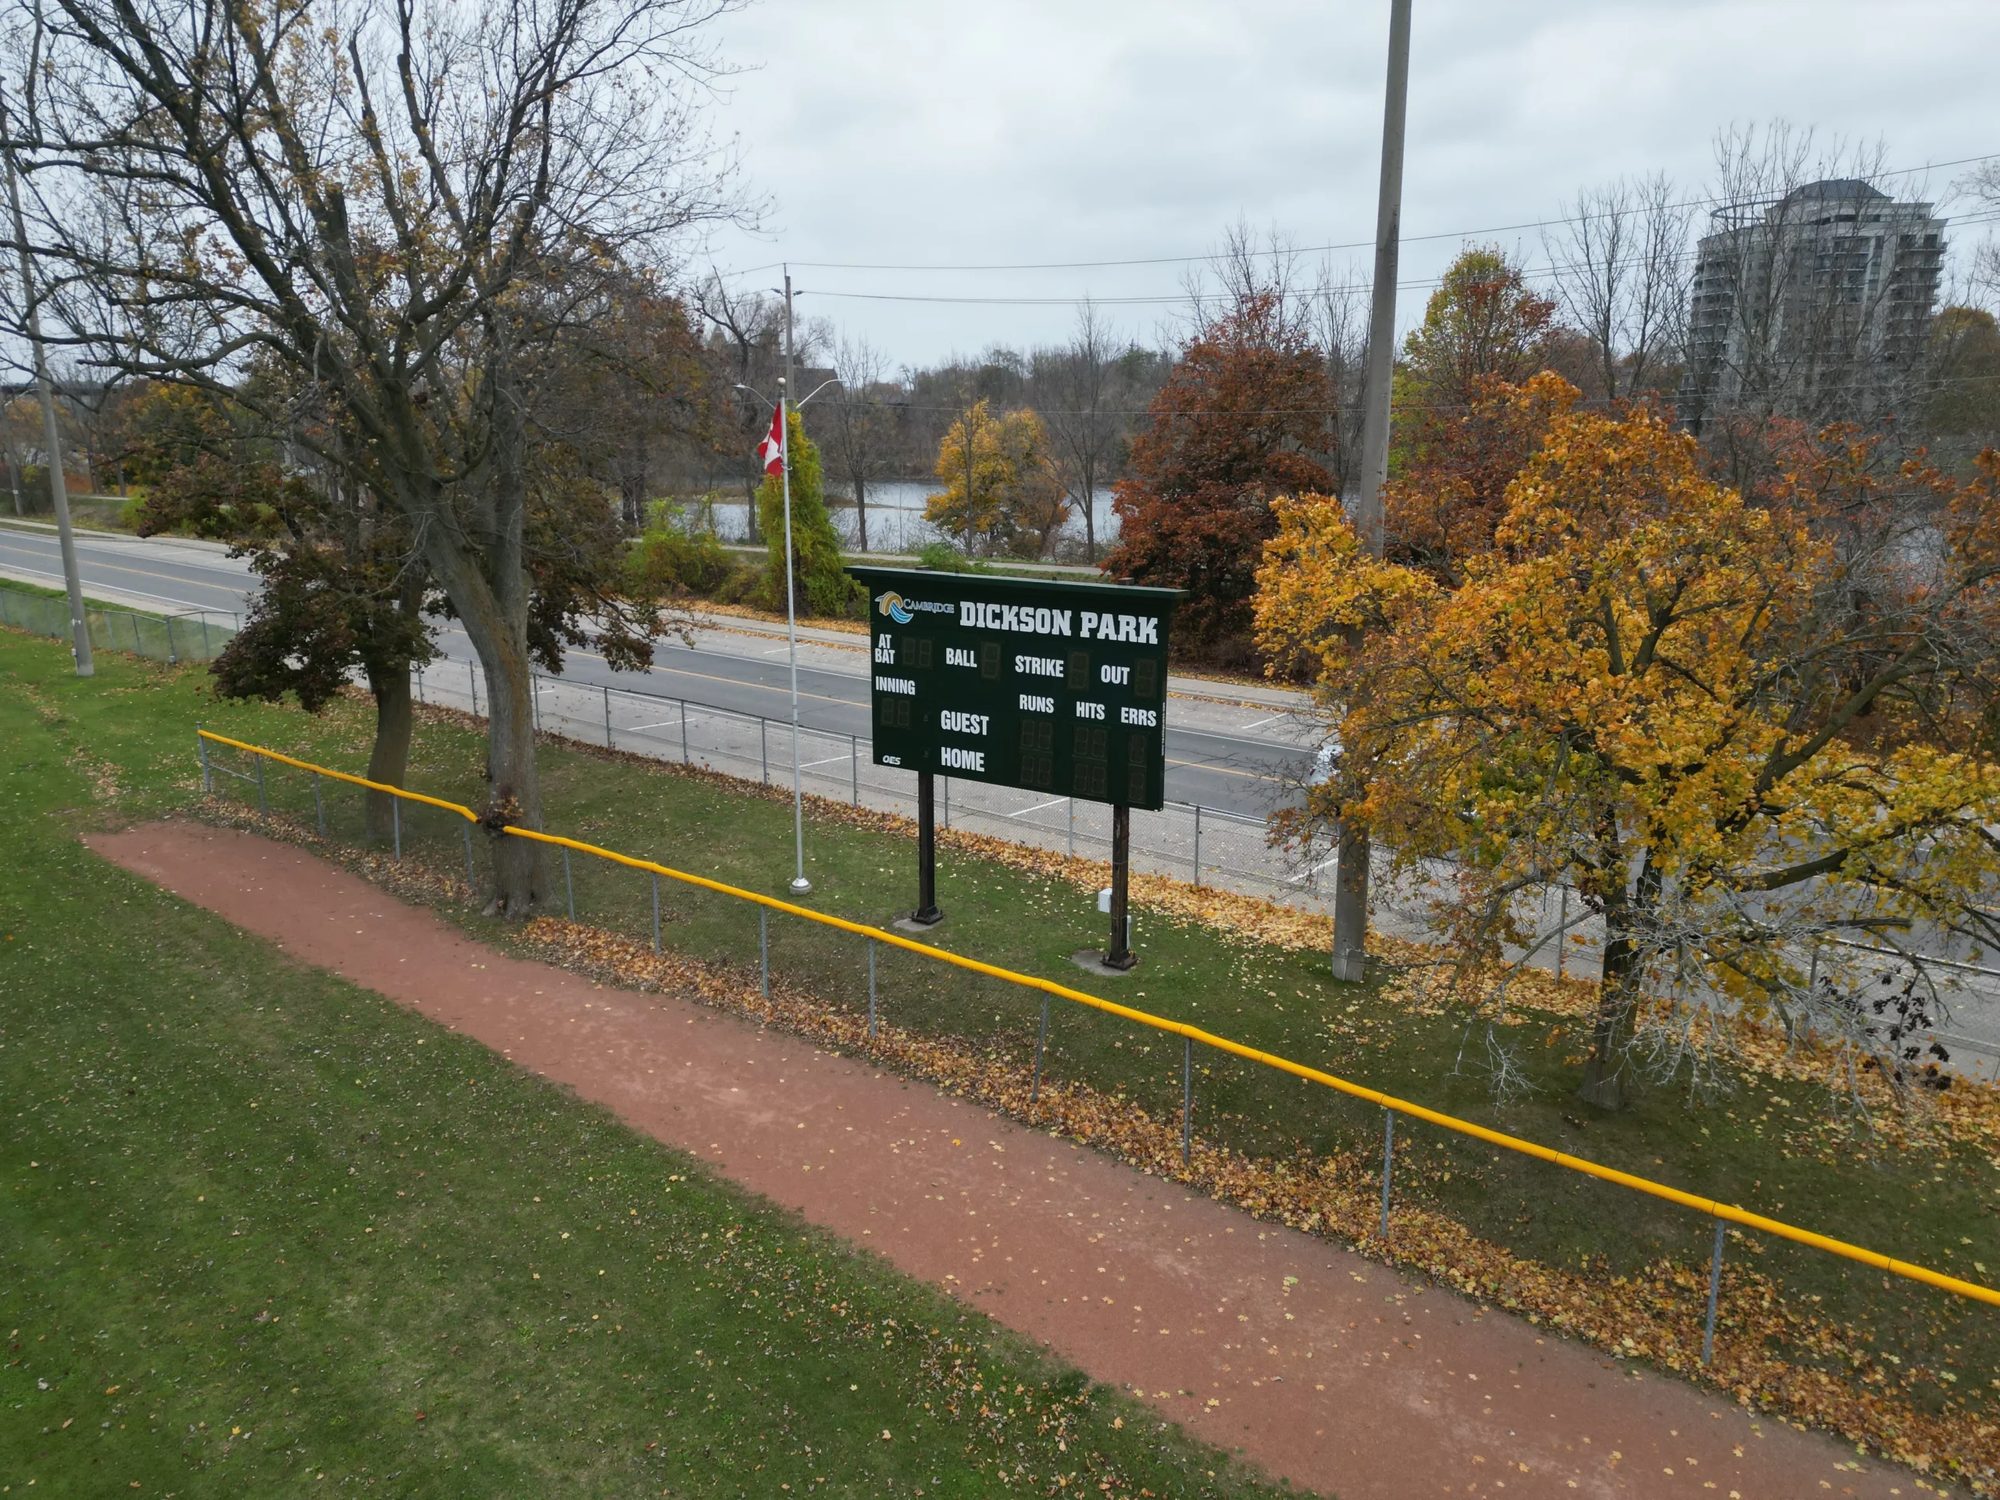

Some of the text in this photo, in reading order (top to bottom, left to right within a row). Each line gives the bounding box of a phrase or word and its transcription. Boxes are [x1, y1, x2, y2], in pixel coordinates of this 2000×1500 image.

[903, 598, 955, 614] CAMBRIDGE
[959, 601, 1159, 645] DICKSON PARK
[878, 633, 892, 649] AT
[874, 649, 896, 665] BAT
[945, 647, 978, 668] BALL
[1014, 654, 1065, 678] STRIKE
[1100, 664, 1130, 685] OUT
[875, 676, 916, 696] INNING
[1019, 694, 1055, 714] RUNS
[1076, 701, 1105, 720] HITS
[940, 709, 990, 736] GUEST
[1120, 706, 1157, 727] ERRS
[882, 755, 901, 766] OES
[940, 746, 985, 773] HOME
